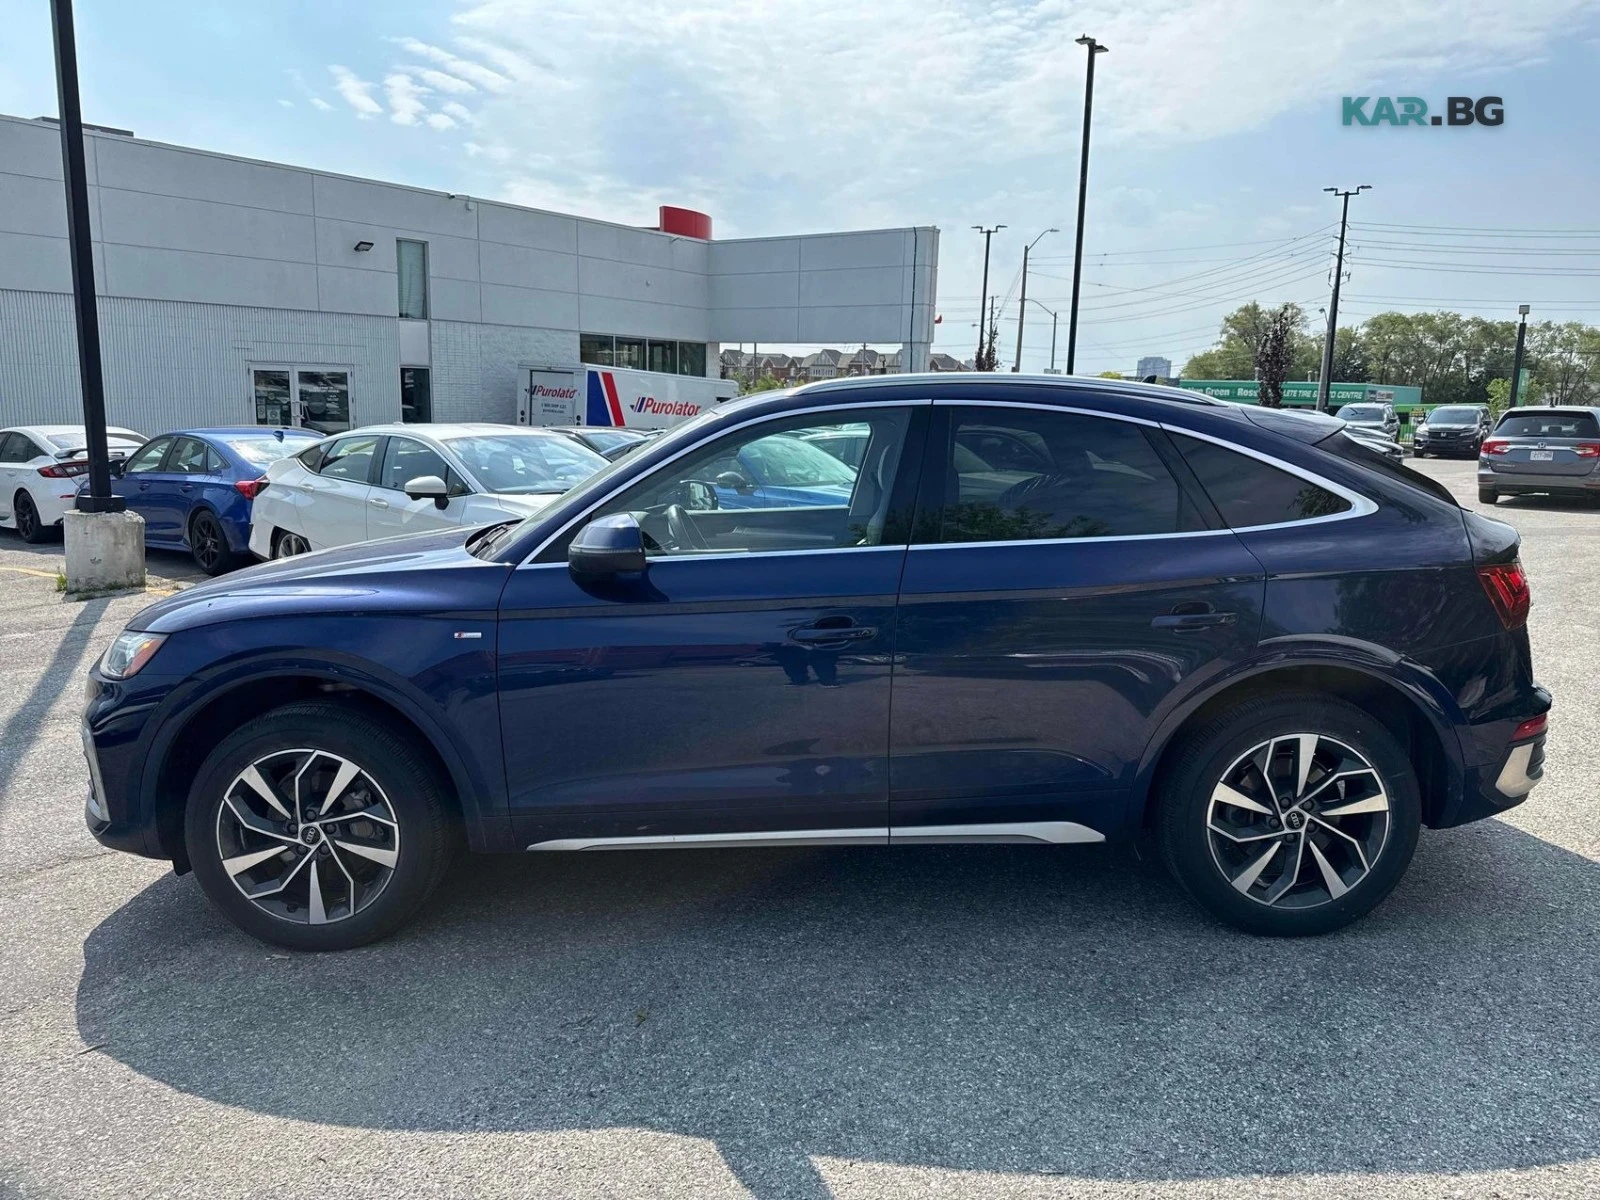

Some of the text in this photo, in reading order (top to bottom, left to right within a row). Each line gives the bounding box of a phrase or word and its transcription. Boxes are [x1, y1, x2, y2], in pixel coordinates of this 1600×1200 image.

[1205, 387, 1230, 396] Green
[1337, 390, 1363, 399] CENTRE
[643, 397, 701, 417] Purolator
